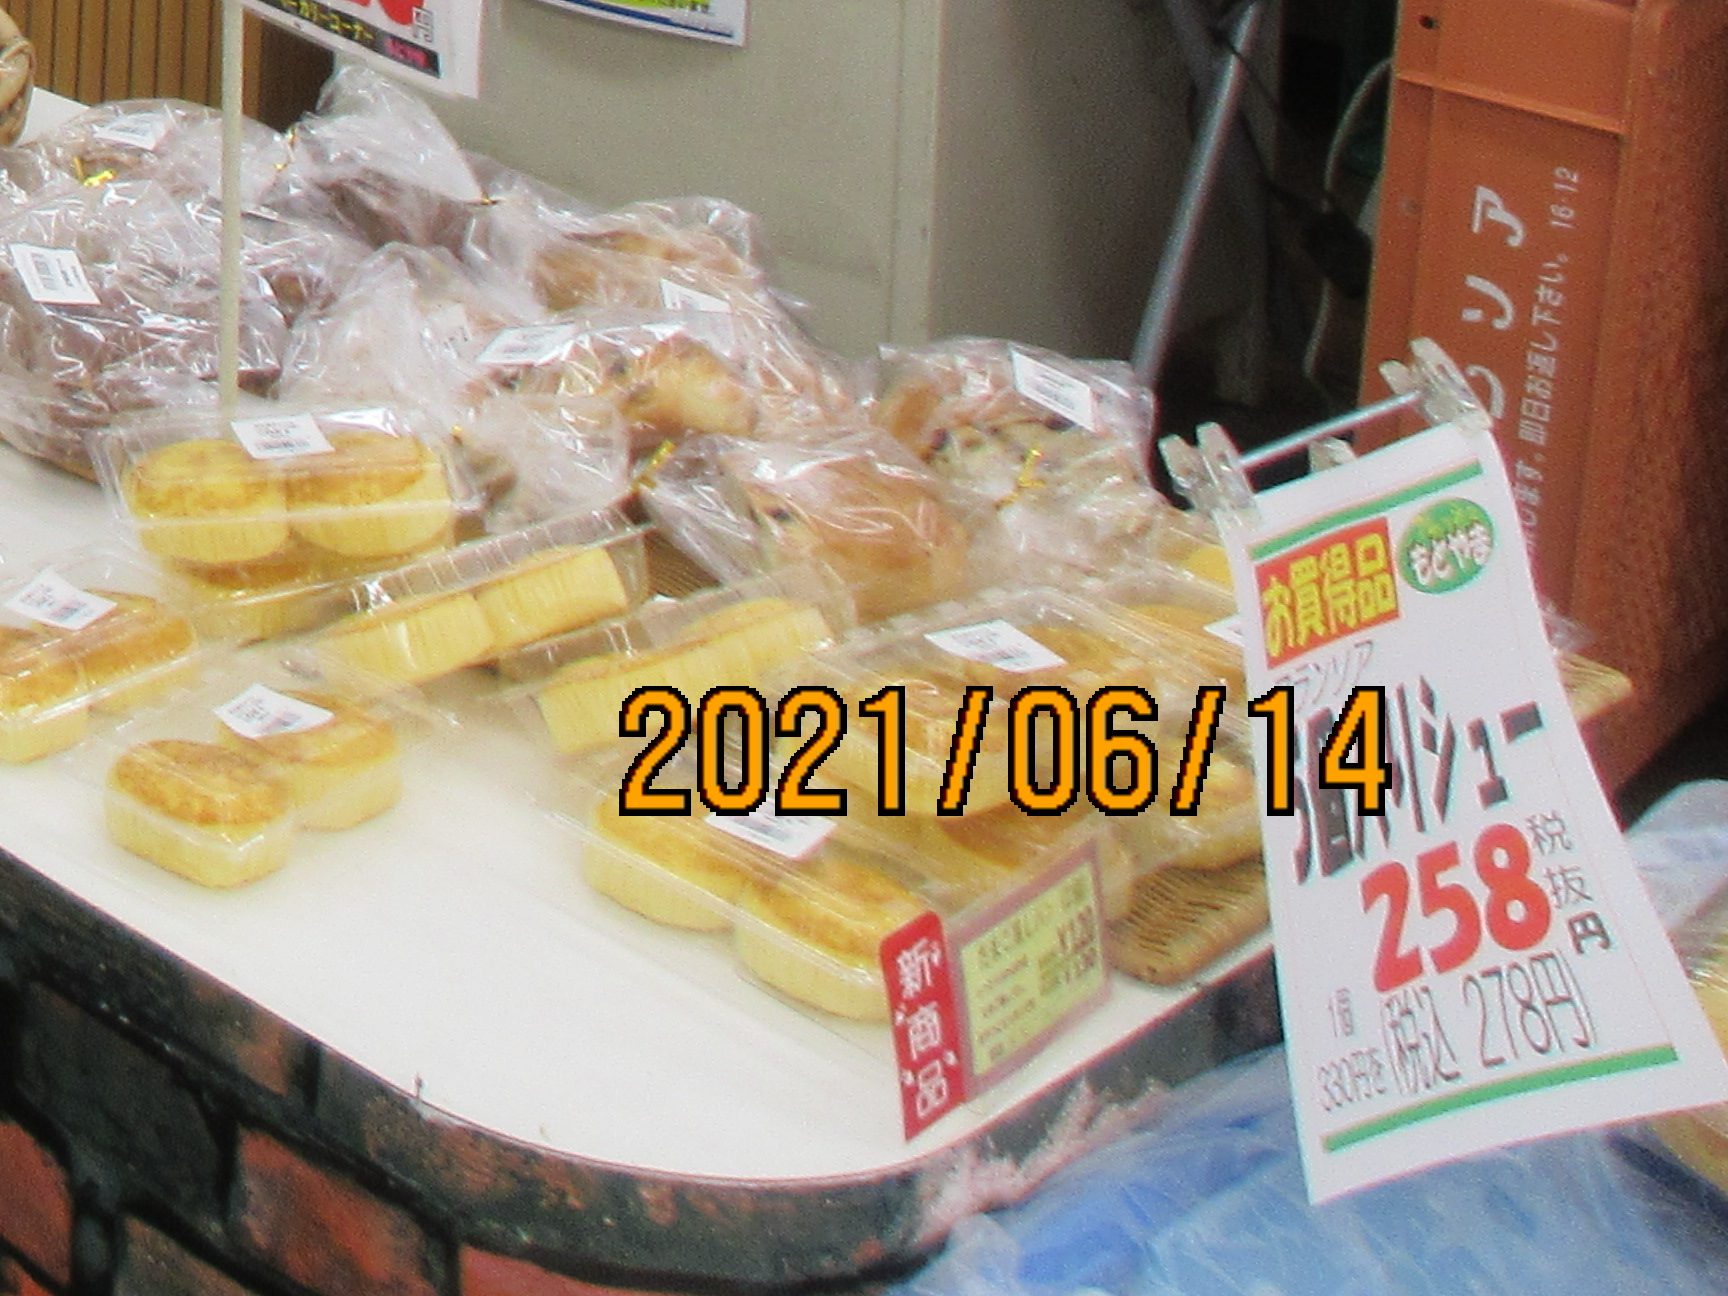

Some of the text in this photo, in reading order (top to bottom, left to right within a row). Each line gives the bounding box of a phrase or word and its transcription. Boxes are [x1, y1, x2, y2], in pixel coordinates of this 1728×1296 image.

[1262, 532, 1400, 659] お買得品
[1410, 521, 1492, 587] もとやま
[1361, 821, 1552, 994] 258
[897, 938, 948, 1119] 新商品
